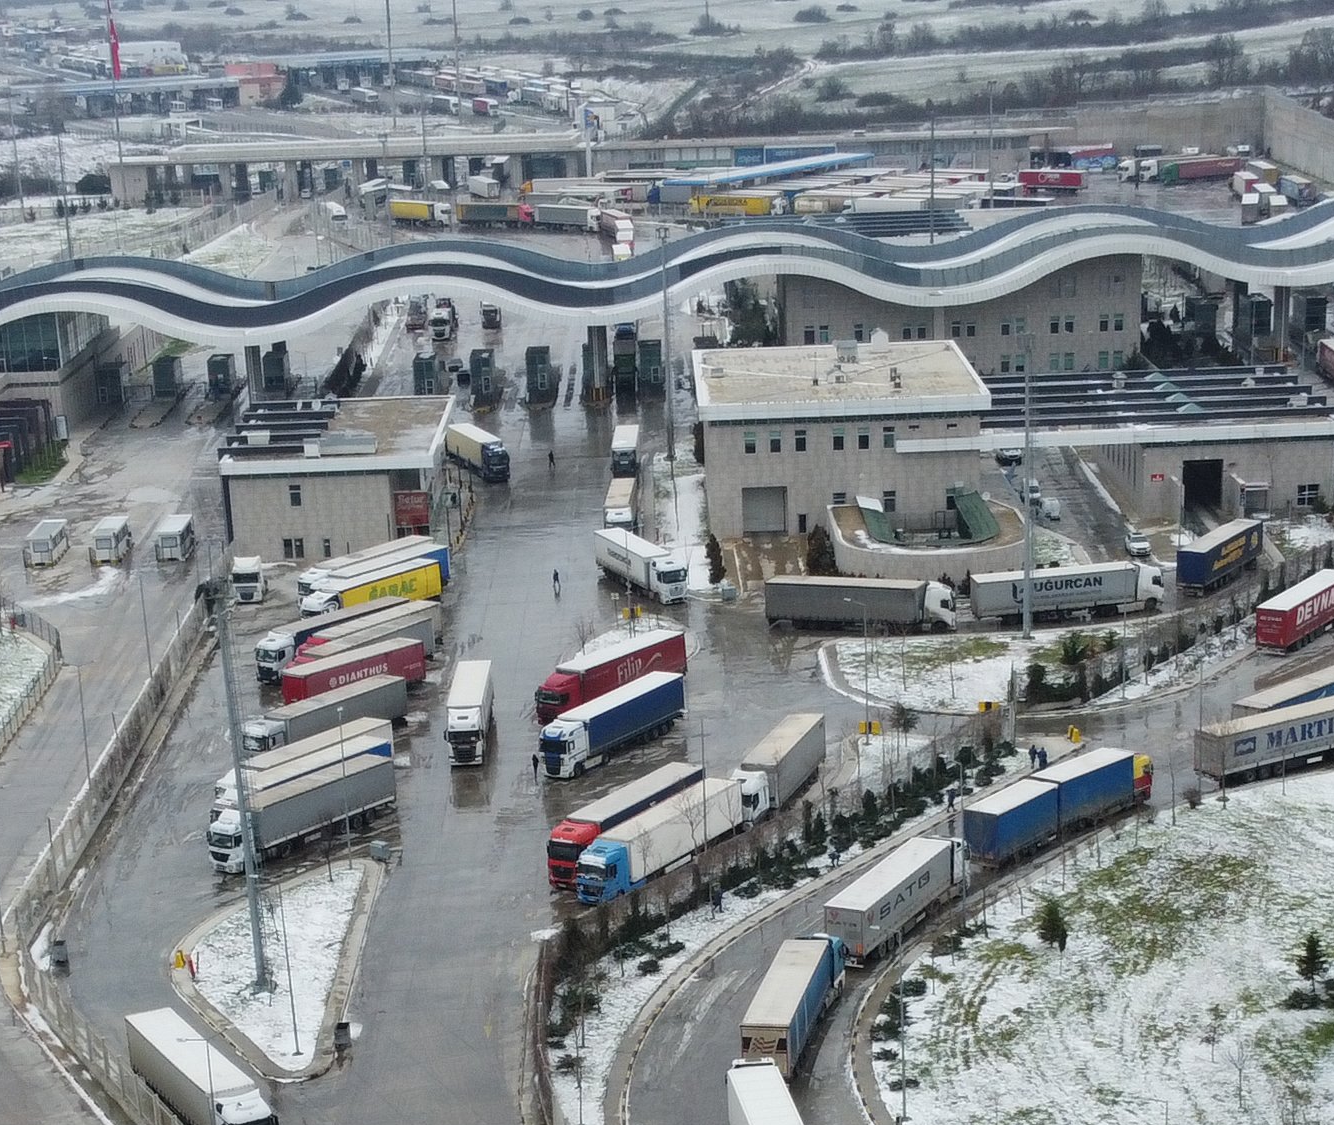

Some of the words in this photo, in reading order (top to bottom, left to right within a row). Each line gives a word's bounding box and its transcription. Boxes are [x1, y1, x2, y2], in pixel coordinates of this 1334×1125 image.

[1033, 576, 1103, 593] UĞURCAN
[338, 662, 389, 685] DIANTHUS
[616, 655, 643, 685] Filip
[1267, 716, 1334, 750] MARTI
